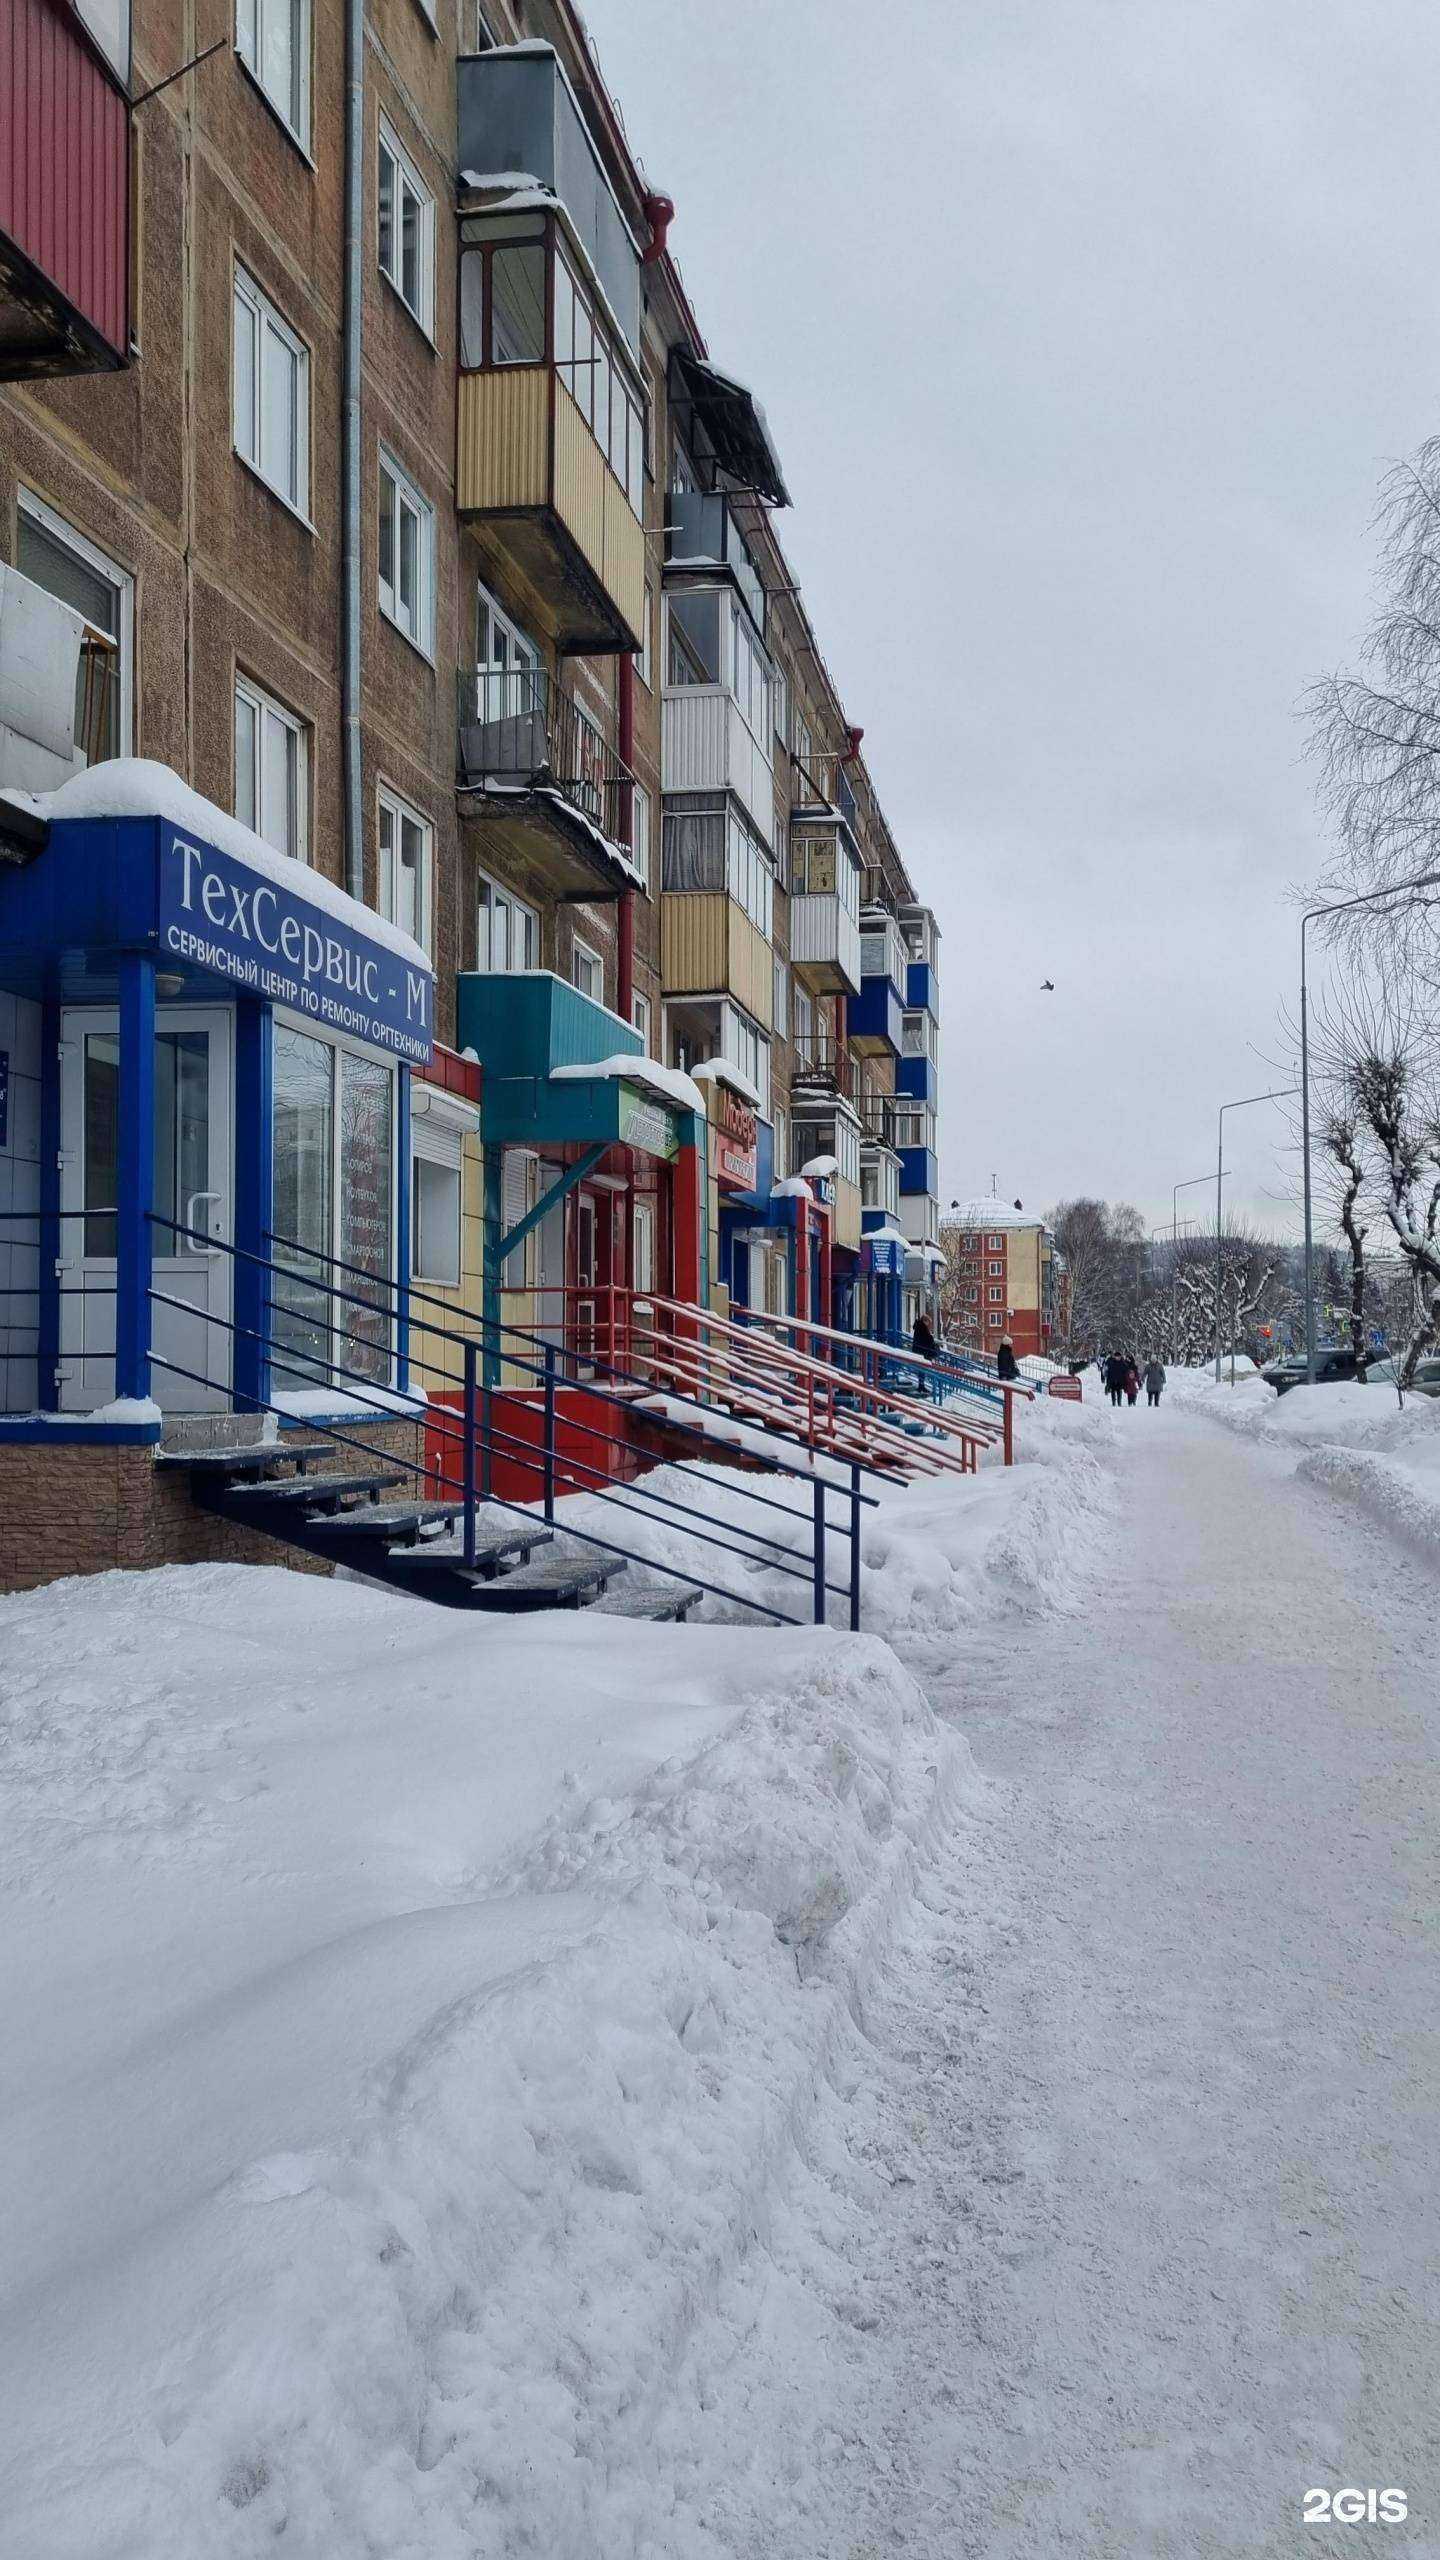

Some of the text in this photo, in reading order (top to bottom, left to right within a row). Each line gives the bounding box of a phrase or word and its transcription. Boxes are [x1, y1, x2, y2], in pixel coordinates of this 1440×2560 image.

[167, 925, 430, 1062] СЕРВИСНЫЙ ЦЕНТР ПО РЕМОНТУ ОРГТЕХНИКИ
[172, 837, 379, 1003] ТехСервис
[406, 969, 427, 1028] М
